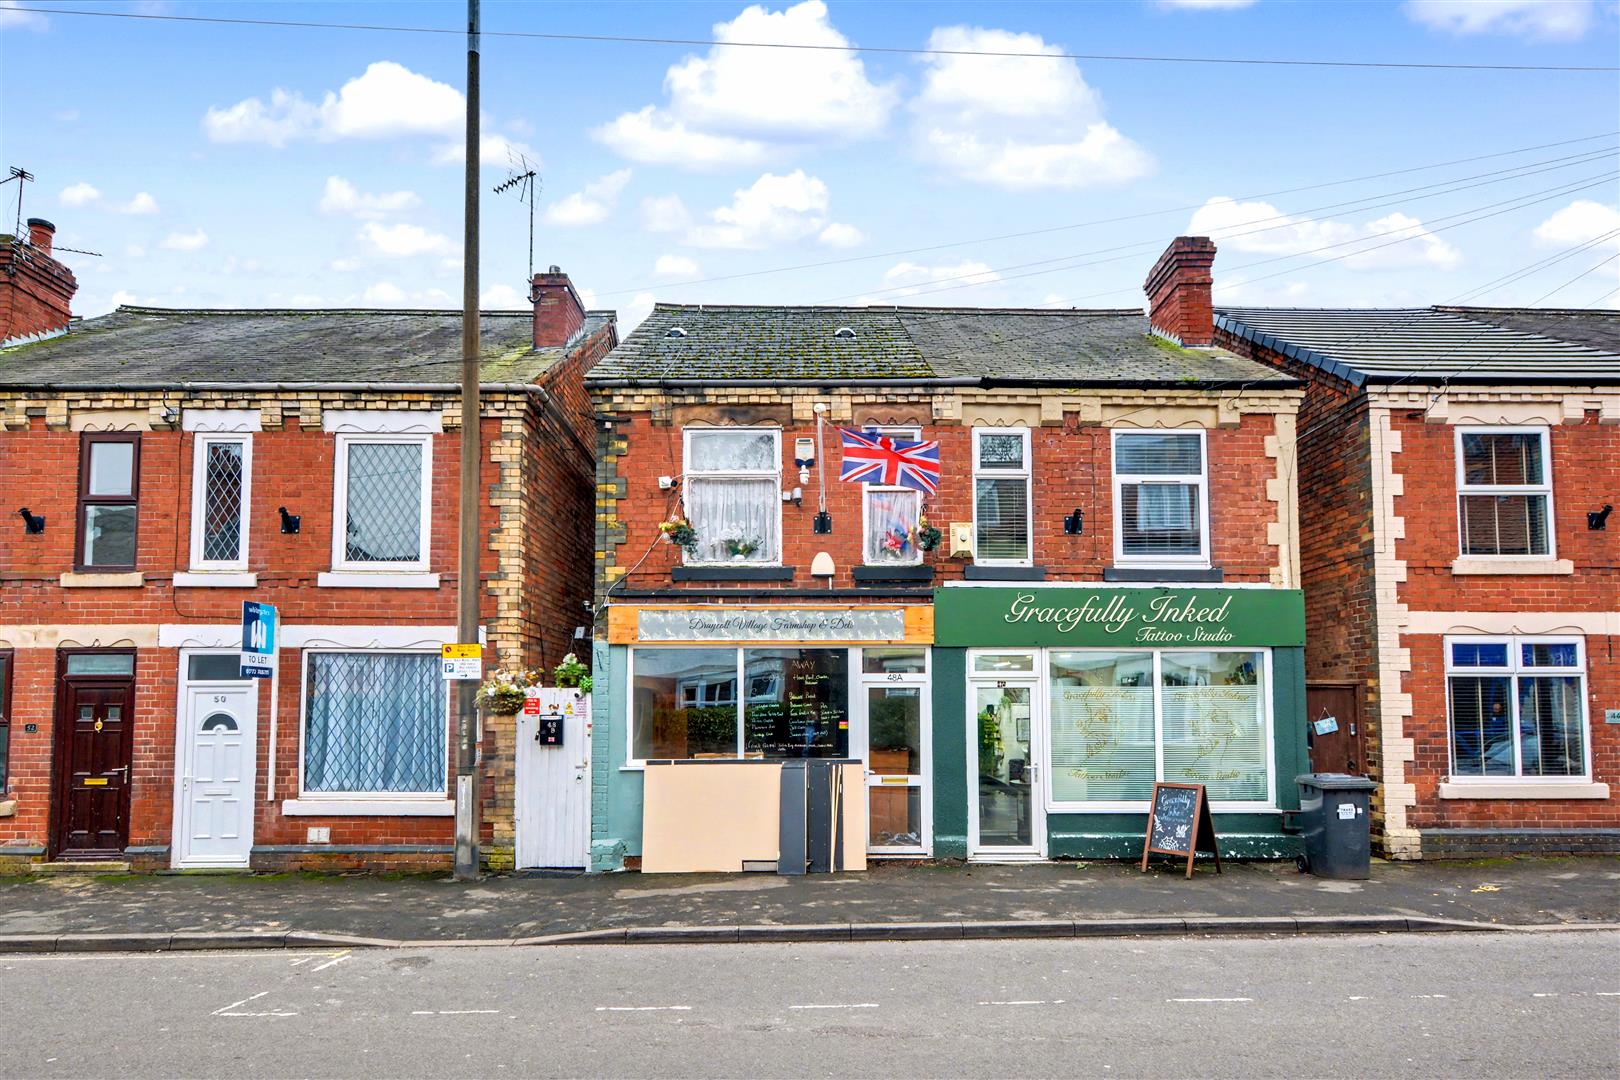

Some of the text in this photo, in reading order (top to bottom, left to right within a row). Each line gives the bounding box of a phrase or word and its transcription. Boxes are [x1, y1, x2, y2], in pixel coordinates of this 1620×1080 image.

[1005, 592, 1233, 633] Gracefully Inked
[689, 617, 731, 633] Draycott
[732, 617, 768, 633] Village
[770, 617, 816, 633] Farmshop
[819, 618, 829, 630] &
[1136, 626, 1235, 643] Tattoo Studio
[248, 655, 267, 664] TO LET
[792, 660, 816, 670] AWAY
[887, 673, 903, 681] 48A
[214, 695, 227, 703] 50
